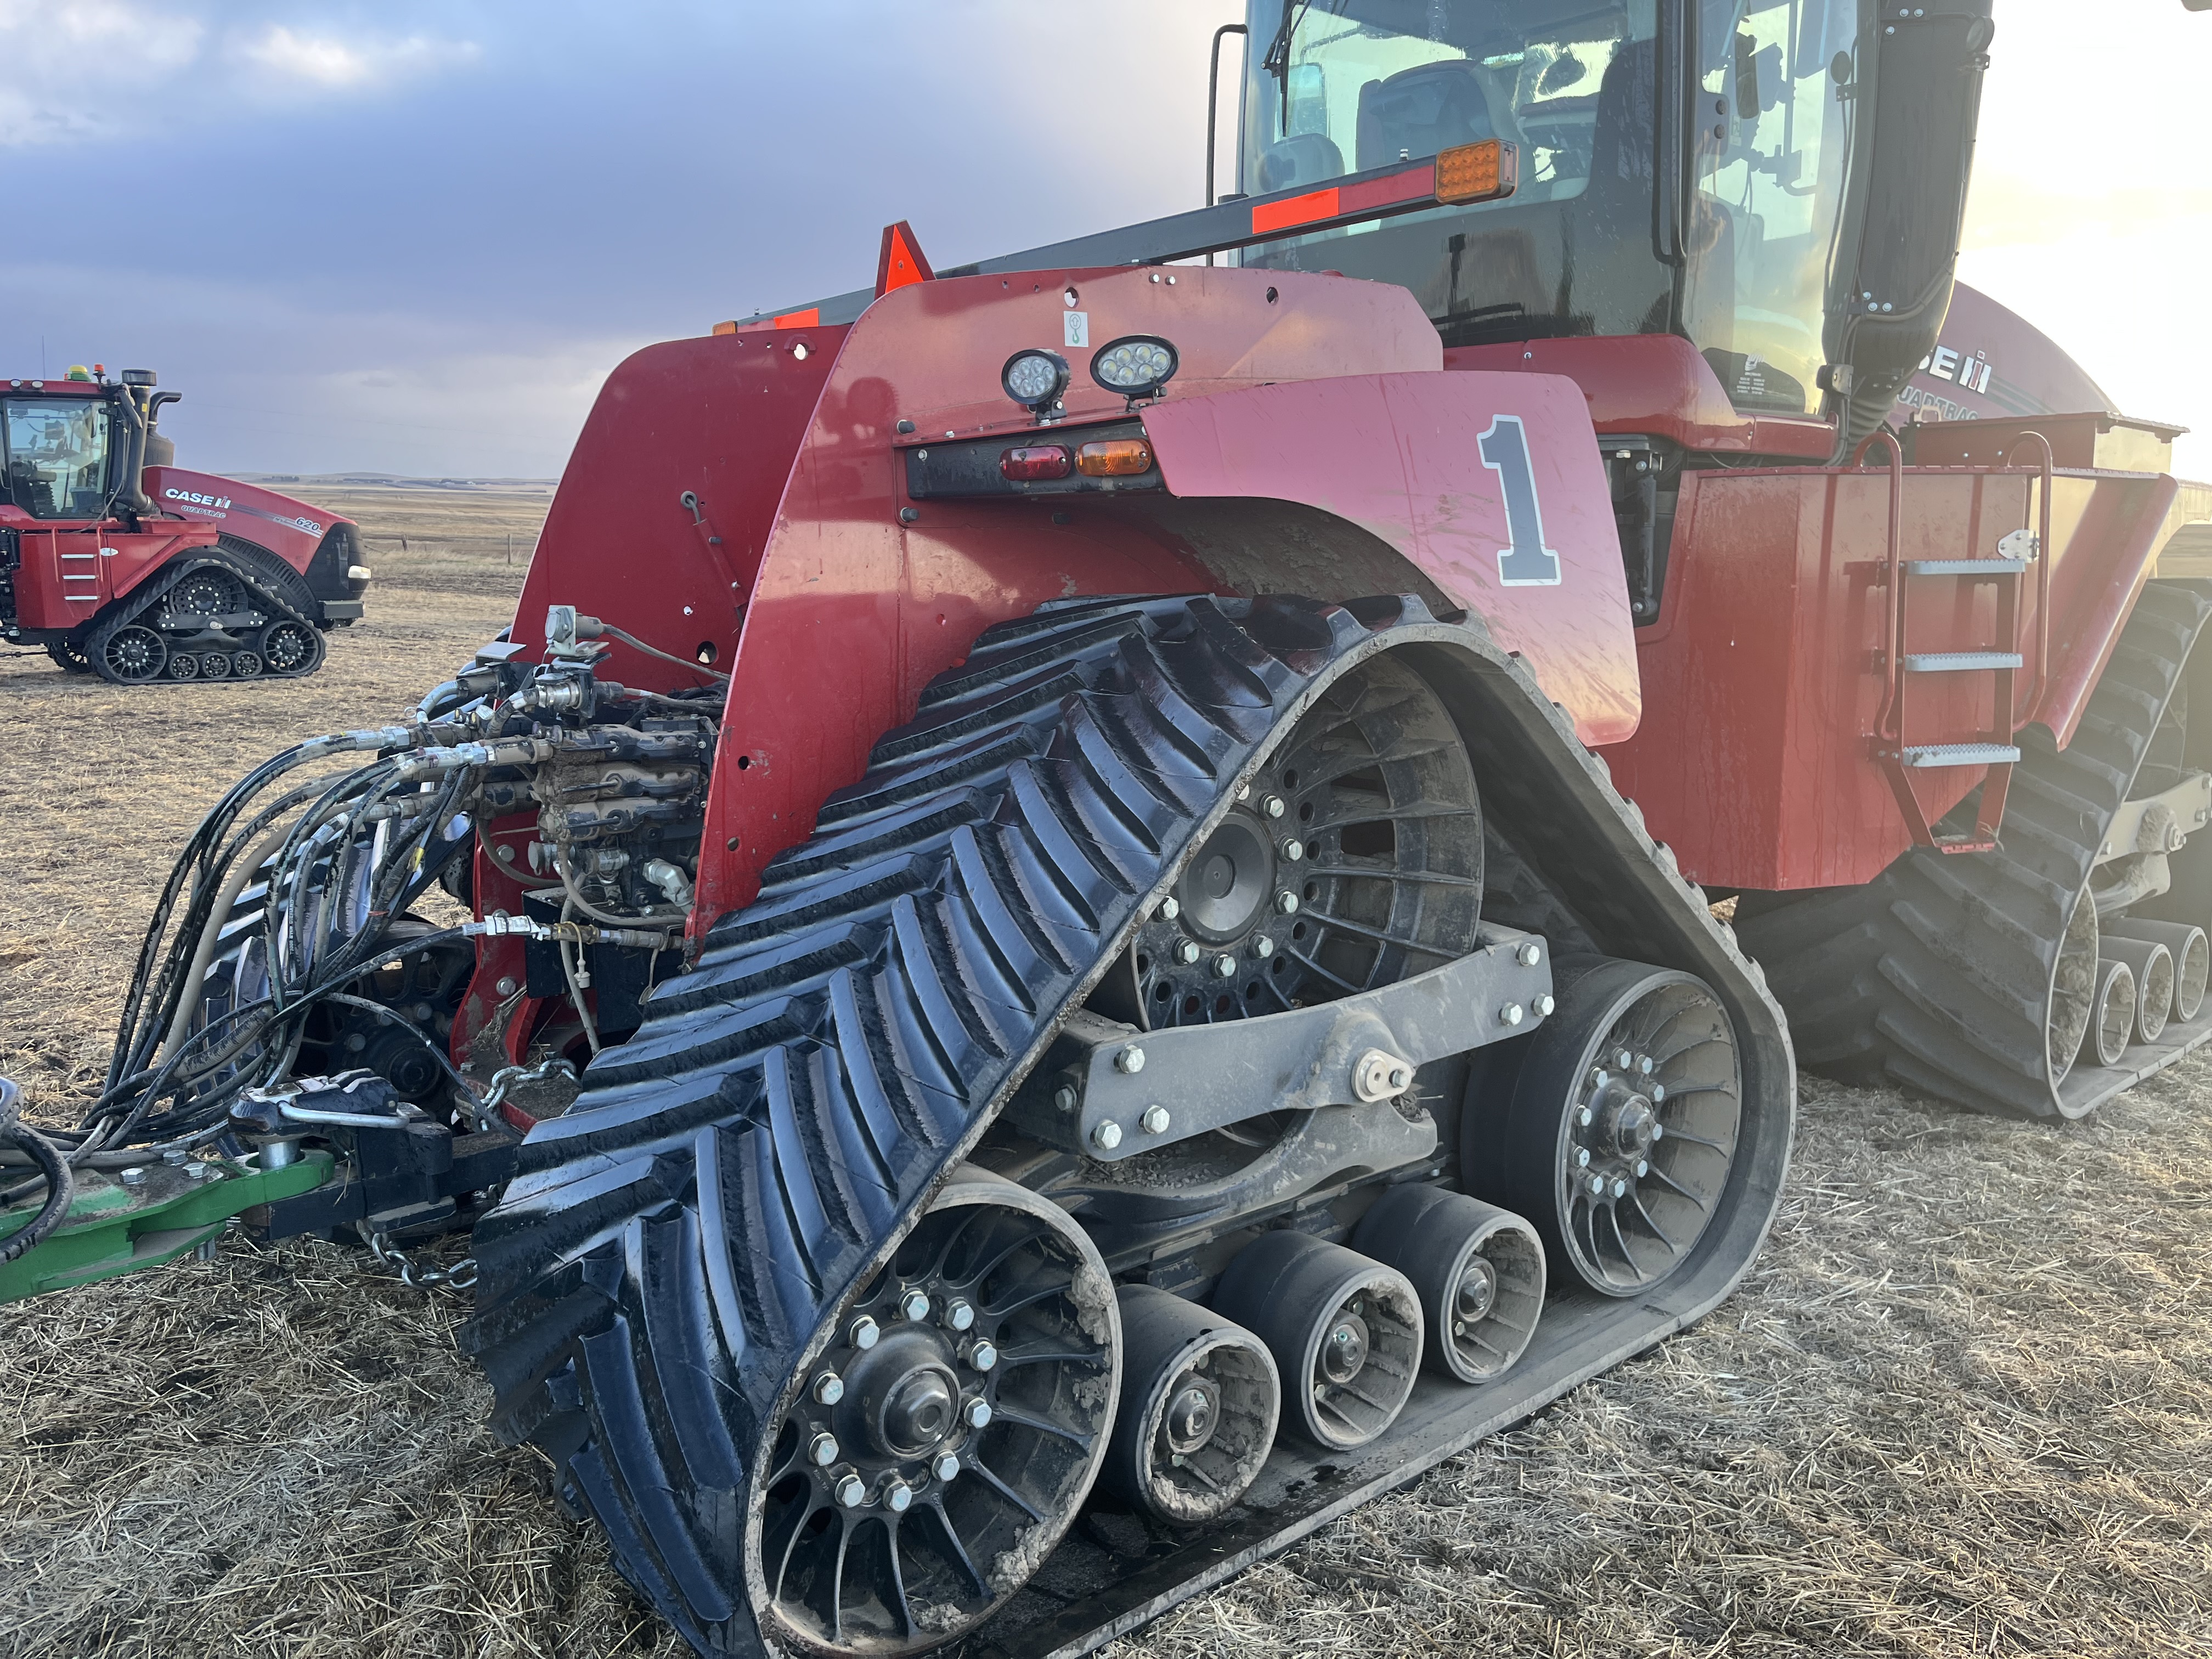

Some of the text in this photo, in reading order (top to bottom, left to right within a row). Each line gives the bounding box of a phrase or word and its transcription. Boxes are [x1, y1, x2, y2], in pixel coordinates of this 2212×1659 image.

[1897, 385, 1979, 420] UADTRA
[165, 488, 215, 505] CASE
[1476, 414, 1561, 586] 1
[181, 505, 226, 518] QUADTRAC
[296, 517, 320, 531] 620
